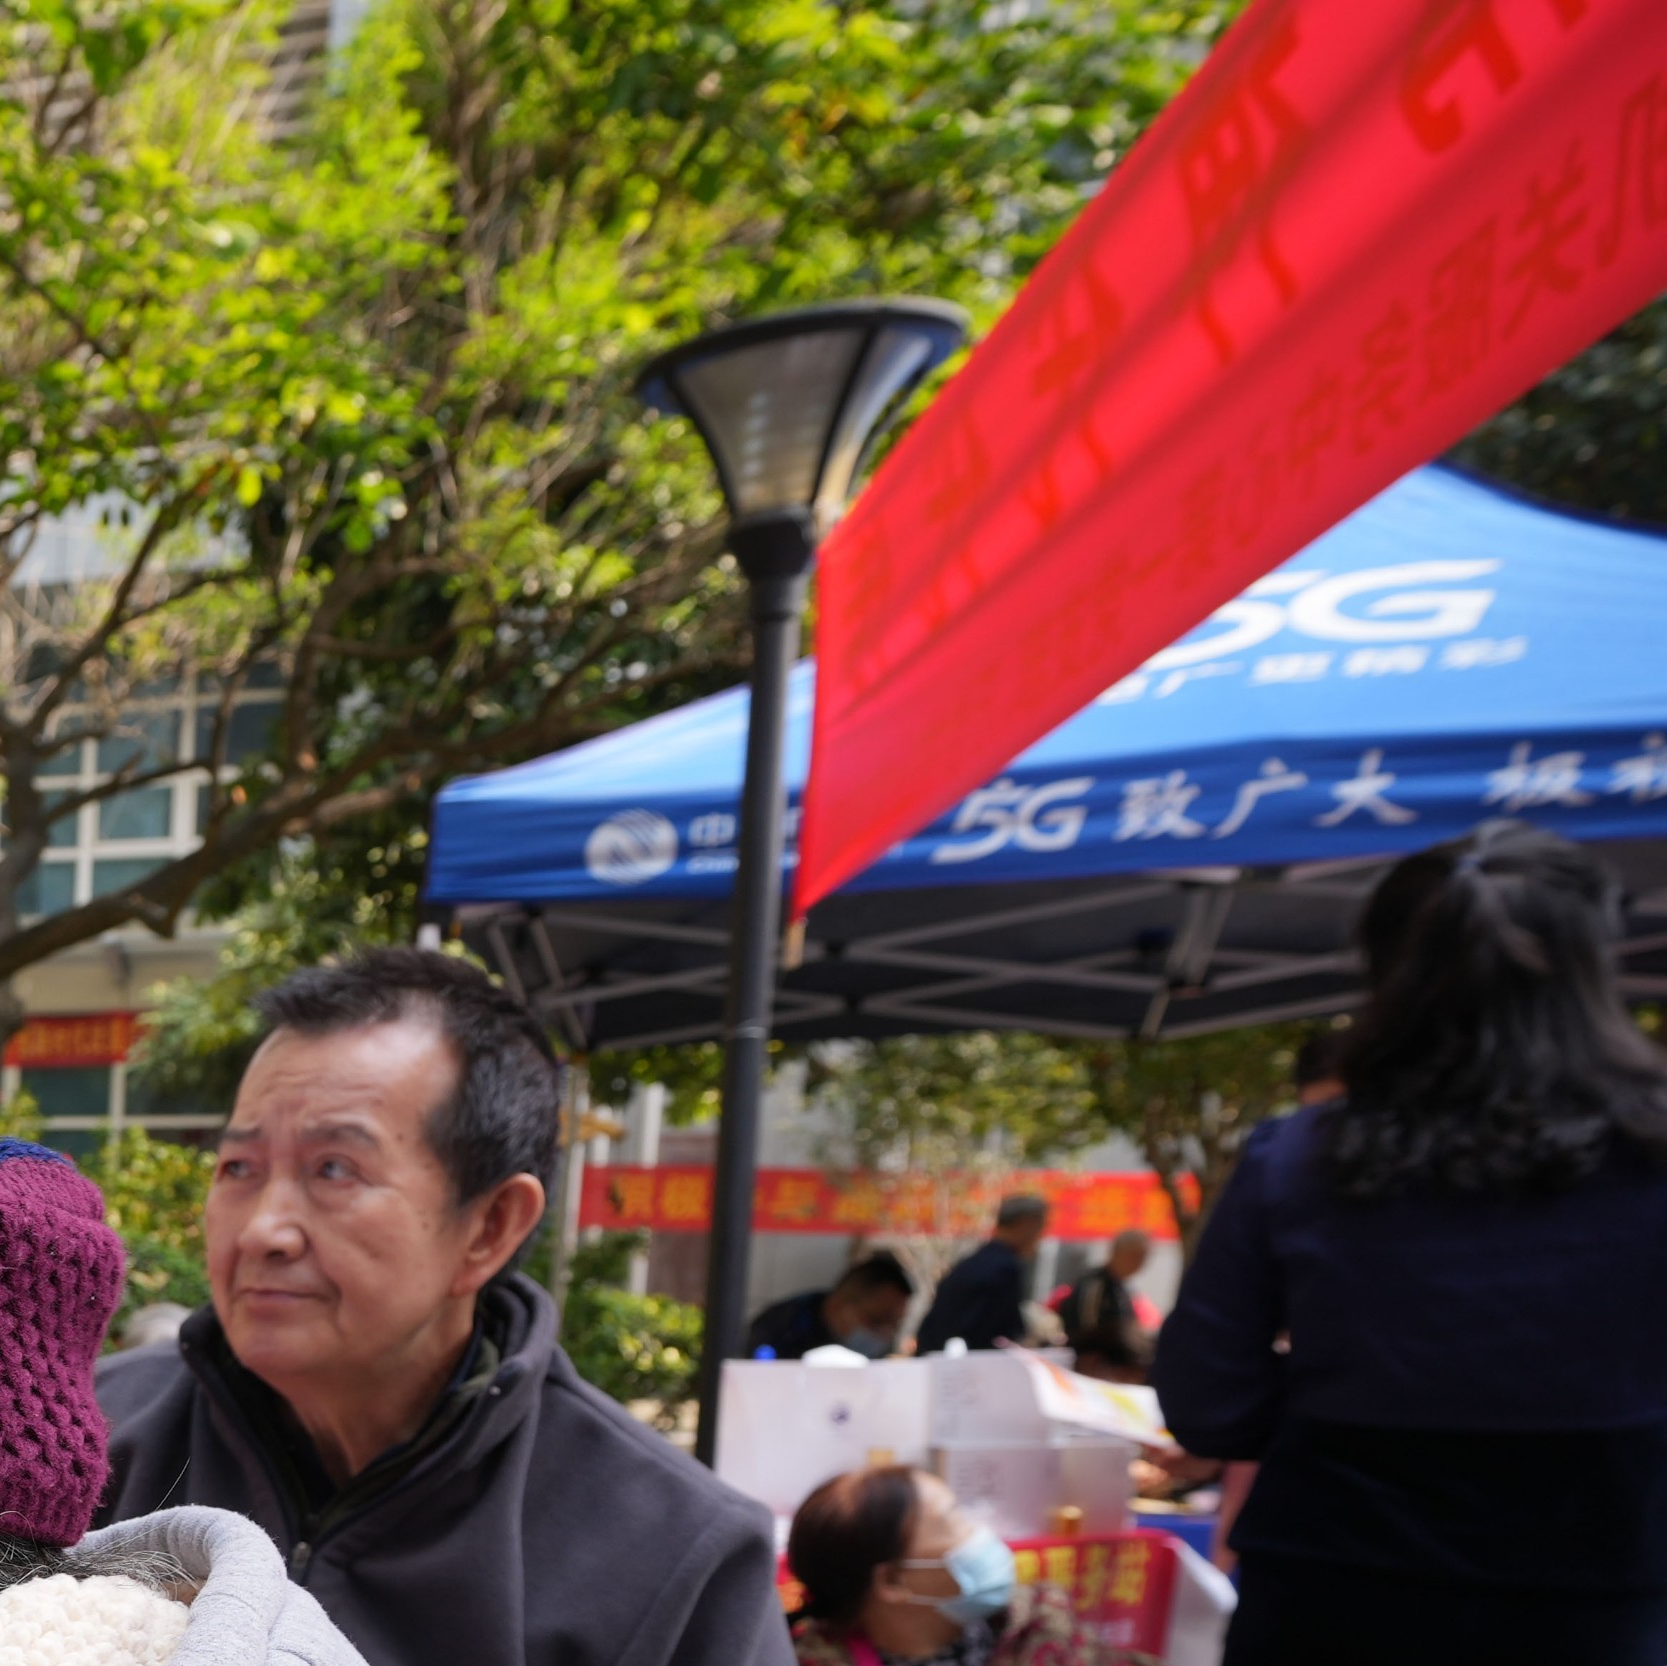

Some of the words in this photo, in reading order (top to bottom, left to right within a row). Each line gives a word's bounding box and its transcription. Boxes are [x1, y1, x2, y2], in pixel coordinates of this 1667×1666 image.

[1142, 557, 1505, 673] 5G
[929, 748, 1418, 864] 5G致广大
